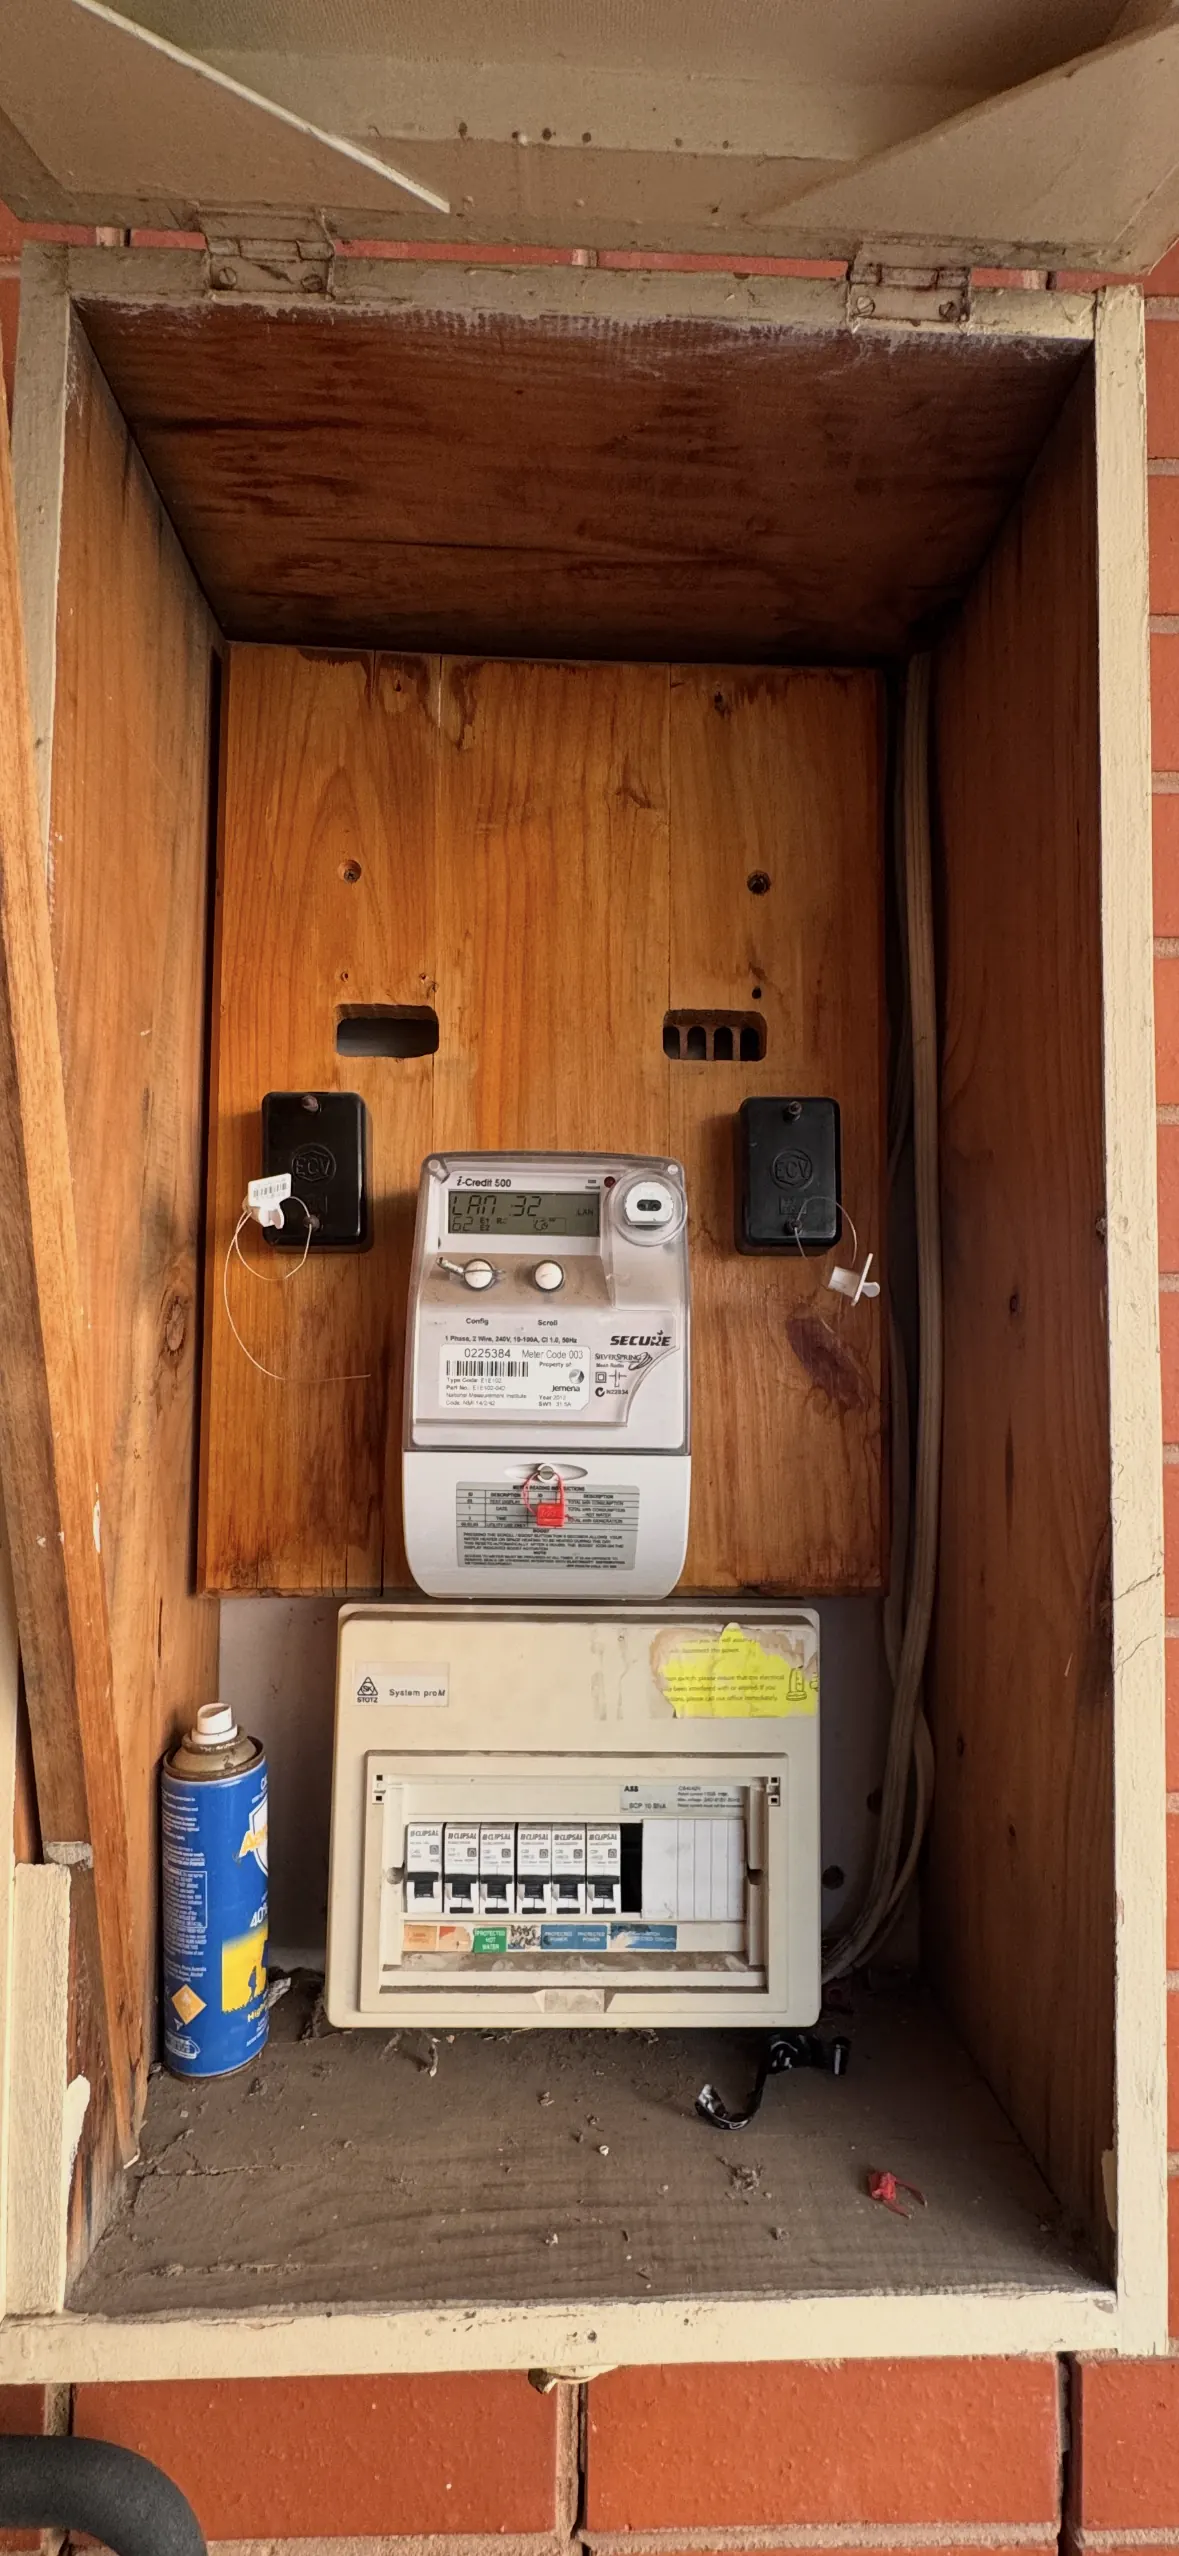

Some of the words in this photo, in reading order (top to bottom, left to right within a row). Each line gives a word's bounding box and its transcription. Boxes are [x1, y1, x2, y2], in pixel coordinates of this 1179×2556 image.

[456, 1176, 492, 1187] i-Credit
[494, 1178, 512, 1188] 500
[465, 1317, 489, 1326] Config
[609, 1334, 672, 1346] SECURE
[464, 1348, 511, 1358] 0225384
[521, 1349, 544, 1359] Meter
[546, 1349, 567, 1359] Code
[569, 1350, 584, 1359] 003
[389, 1688, 421, 1698] System
[453, 1832, 477, 1840] CLIPSAL
[487, 1833, 511, 1841] CLIPSAL
[525, 1833, 549, 1841] CLIPSAL
[559, 1833, 583, 1841] CLIPSAL
[594, 1833, 618, 1841] CLIPSAL
